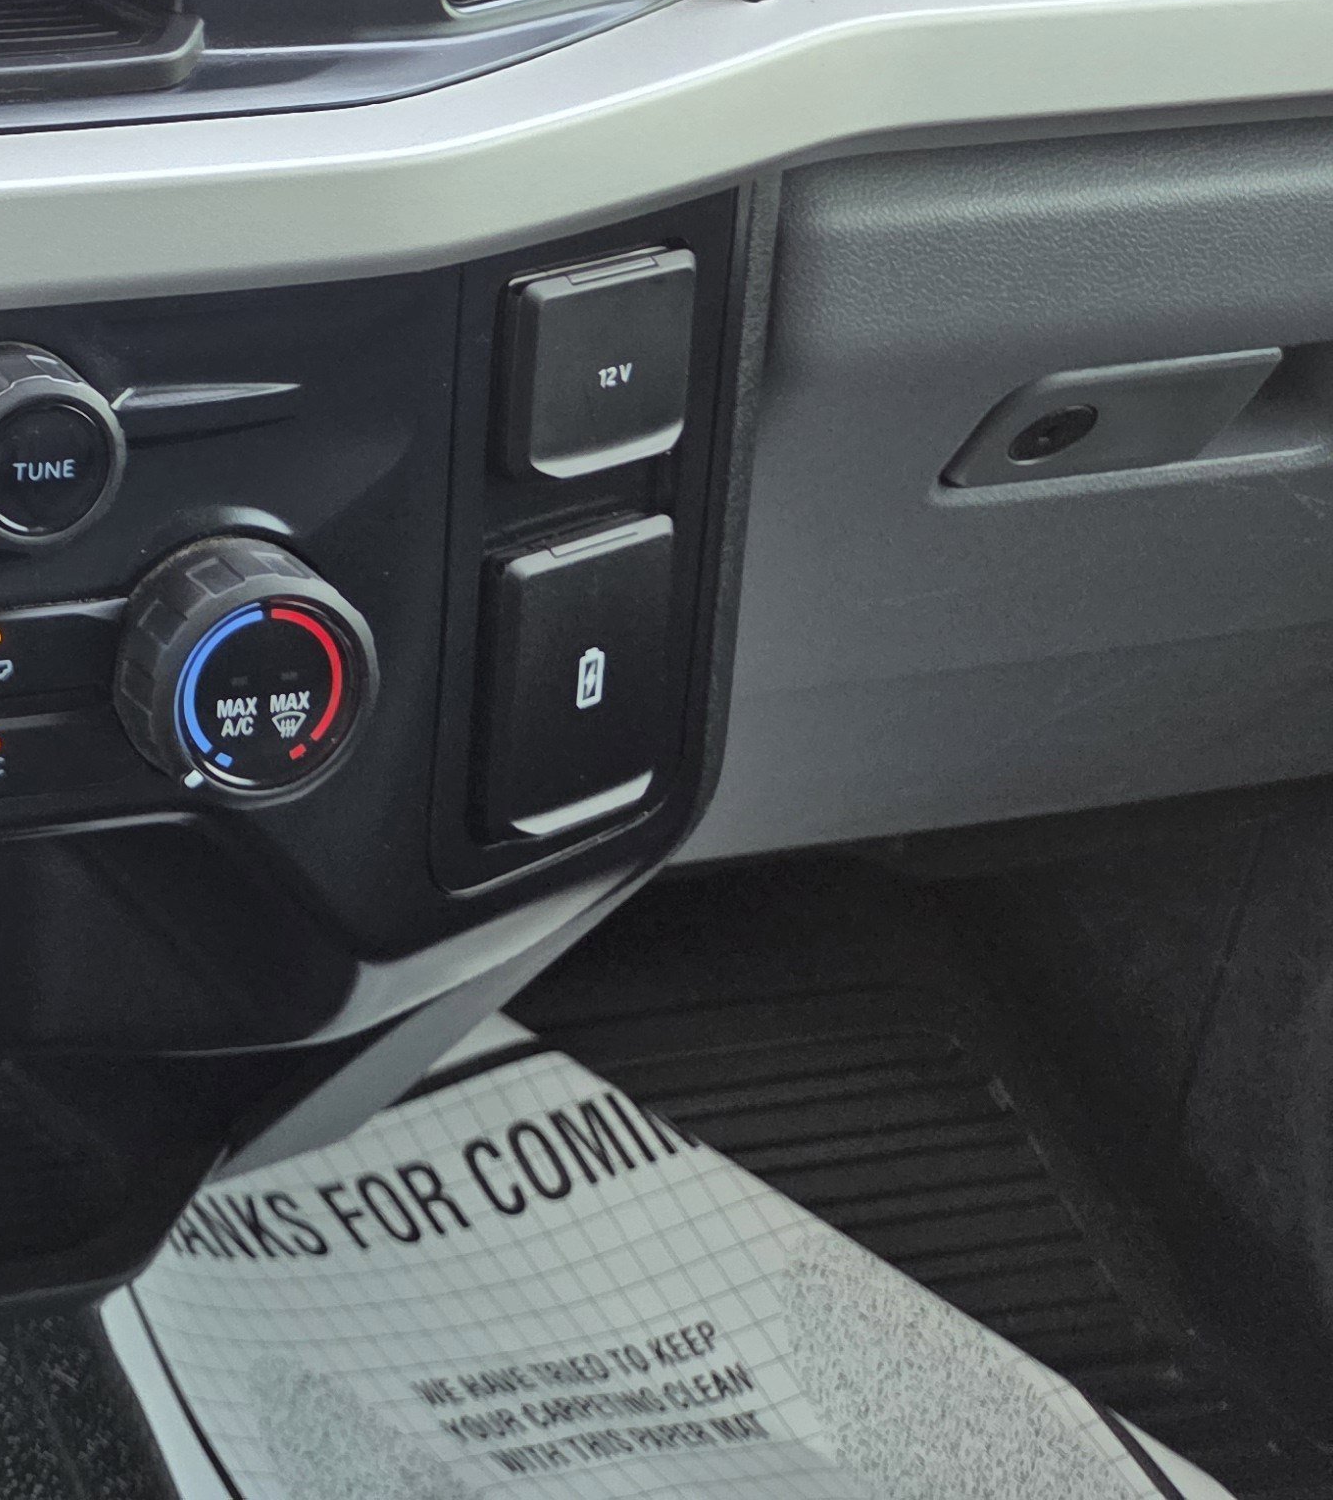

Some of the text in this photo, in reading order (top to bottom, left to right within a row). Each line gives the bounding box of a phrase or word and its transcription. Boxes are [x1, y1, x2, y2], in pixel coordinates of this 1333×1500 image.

[12, 458, 76, 484] TUNE
[217, 696, 258, 720] MAX
[269, 690, 311, 713] MAX
[221, 716, 254, 738] A/C
[169, 1190, 329, 1259] ANKS
[318, 1161, 471, 1250] FOR
[410, 1319, 716, 1408] WE HAVE TRIED TO KEEP
[440, 1361, 756, 1445] YOUR CARPETING CLEAN
[490, 1443, 571, 1475] WITH
[565, 1428, 634, 1464] THIS
[627, 1419, 717, 1453] PAPER
